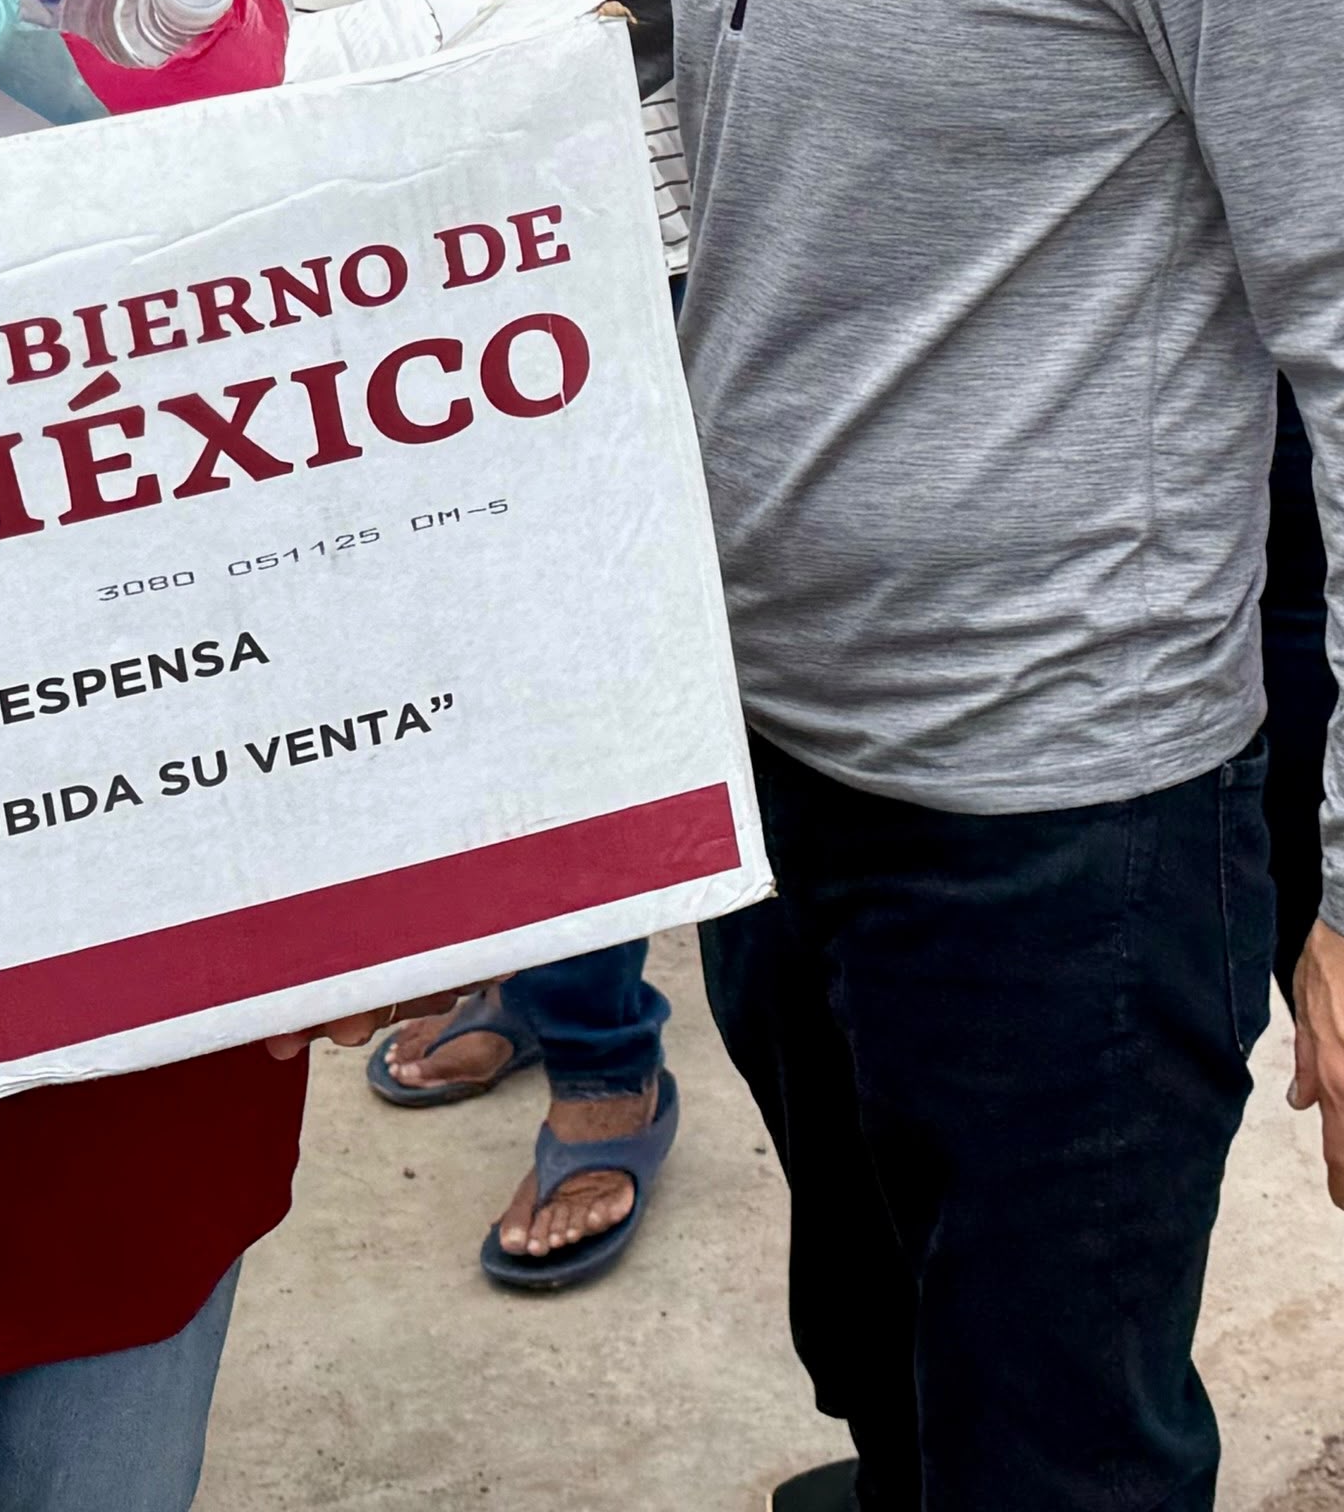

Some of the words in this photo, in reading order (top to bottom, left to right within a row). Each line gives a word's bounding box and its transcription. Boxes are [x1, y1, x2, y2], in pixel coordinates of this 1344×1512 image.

[434, 204, 572, 289] DE
[96, 570, 196, 603] 3080
[227, 526, 381, 577] 051125
[158, 749, 229, 798] SU
[244, 692, 455, 775] VENTA”
